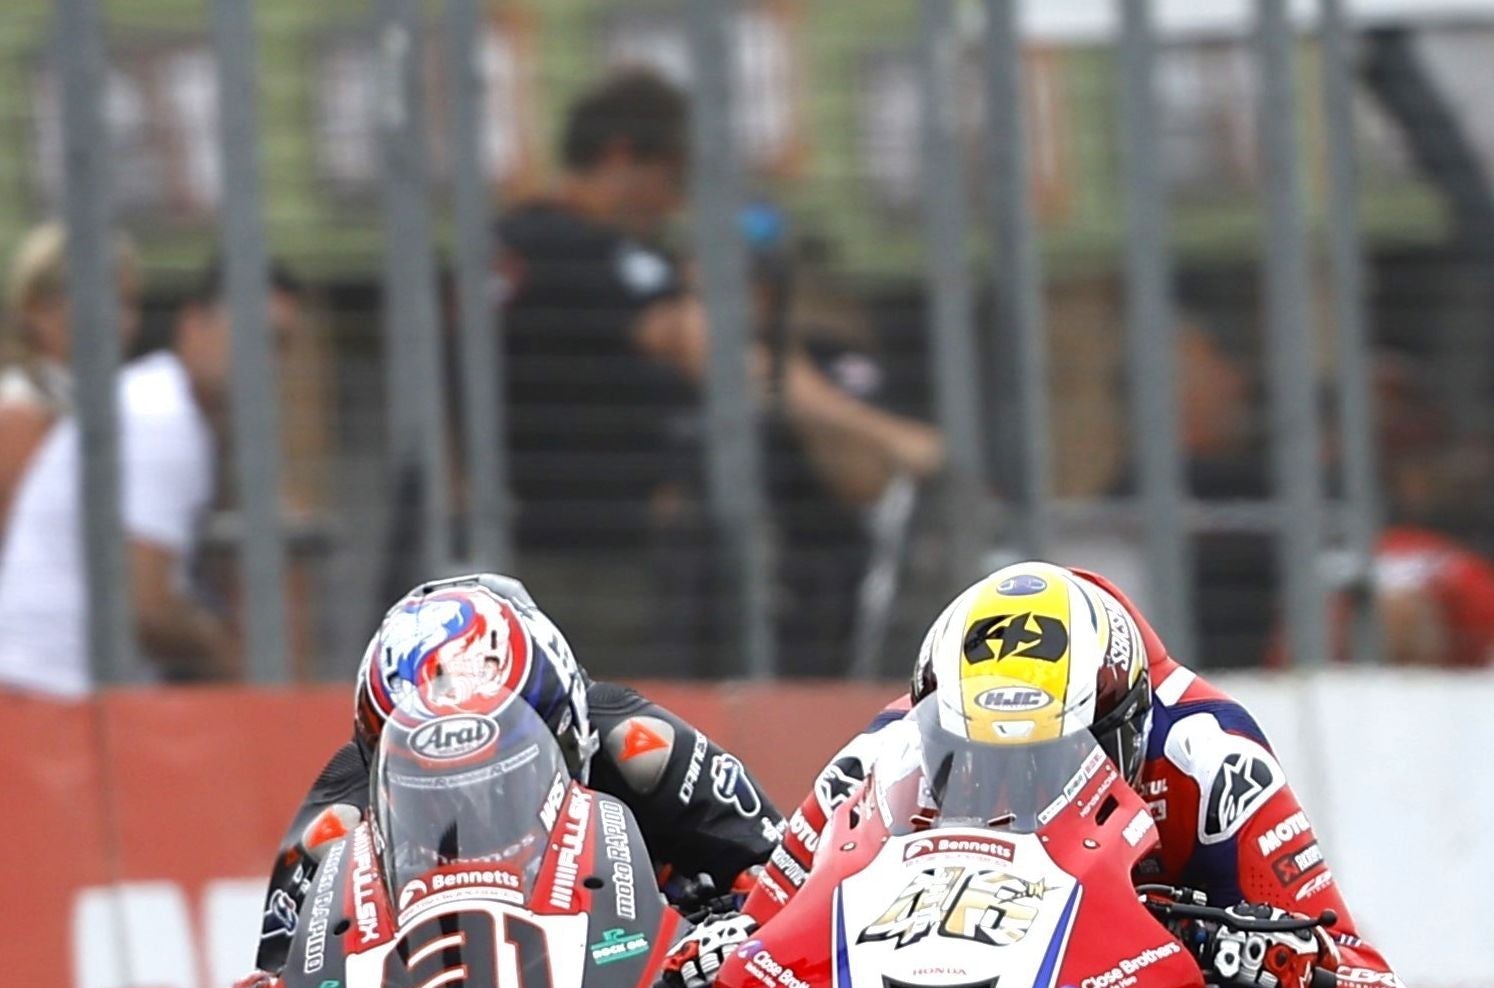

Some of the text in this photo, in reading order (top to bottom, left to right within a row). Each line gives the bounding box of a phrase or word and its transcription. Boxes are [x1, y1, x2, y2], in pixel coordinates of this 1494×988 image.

[984, 691, 1042, 706] HJC
[421, 718, 486, 750] Arai
[938, 840, 1011, 857] Bennetts
[432, 870, 519, 888] Bennetts
[855, 866, 1041, 950] 46
[753, 950, 783, 977] Close
[1118, 941, 1181, 975] Brothers
[912, 966, 967, 976] HONDA
